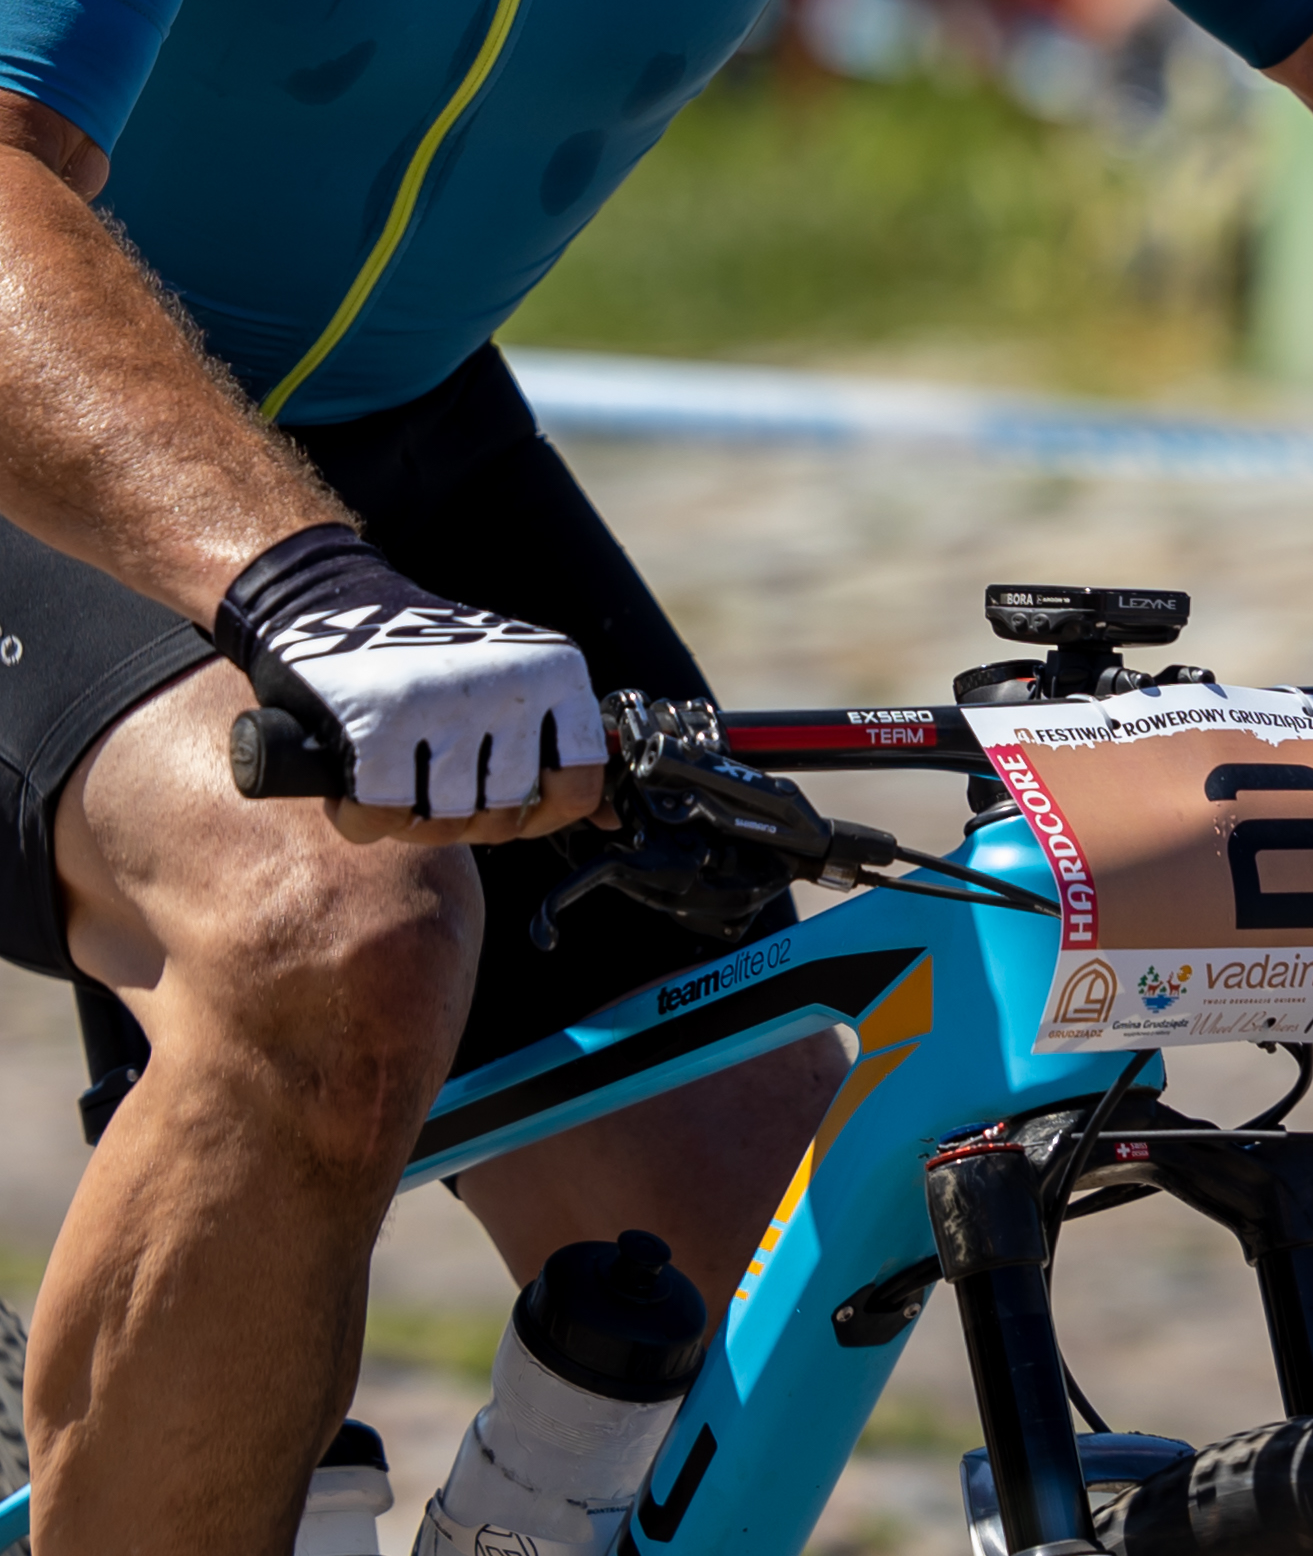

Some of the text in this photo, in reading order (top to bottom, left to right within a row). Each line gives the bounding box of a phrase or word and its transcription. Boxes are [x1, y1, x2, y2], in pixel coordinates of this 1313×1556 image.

[1007, 593, 1033, 605] BORA
[1118, 595, 1176, 610] LEZYNE
[847, 710, 934, 724] EXSERO
[1035, 726, 1122, 742] FESTIWAL
[1122, 708, 1227, 736] ROWEROWY
[866, 728, 924, 744] TEAM
[713, 761, 763, 782] XT
[996, 752, 1094, 942] HARDCORE
[768, 938, 791, 968] 02
[1112, 1020, 1141, 1030] Gmina
